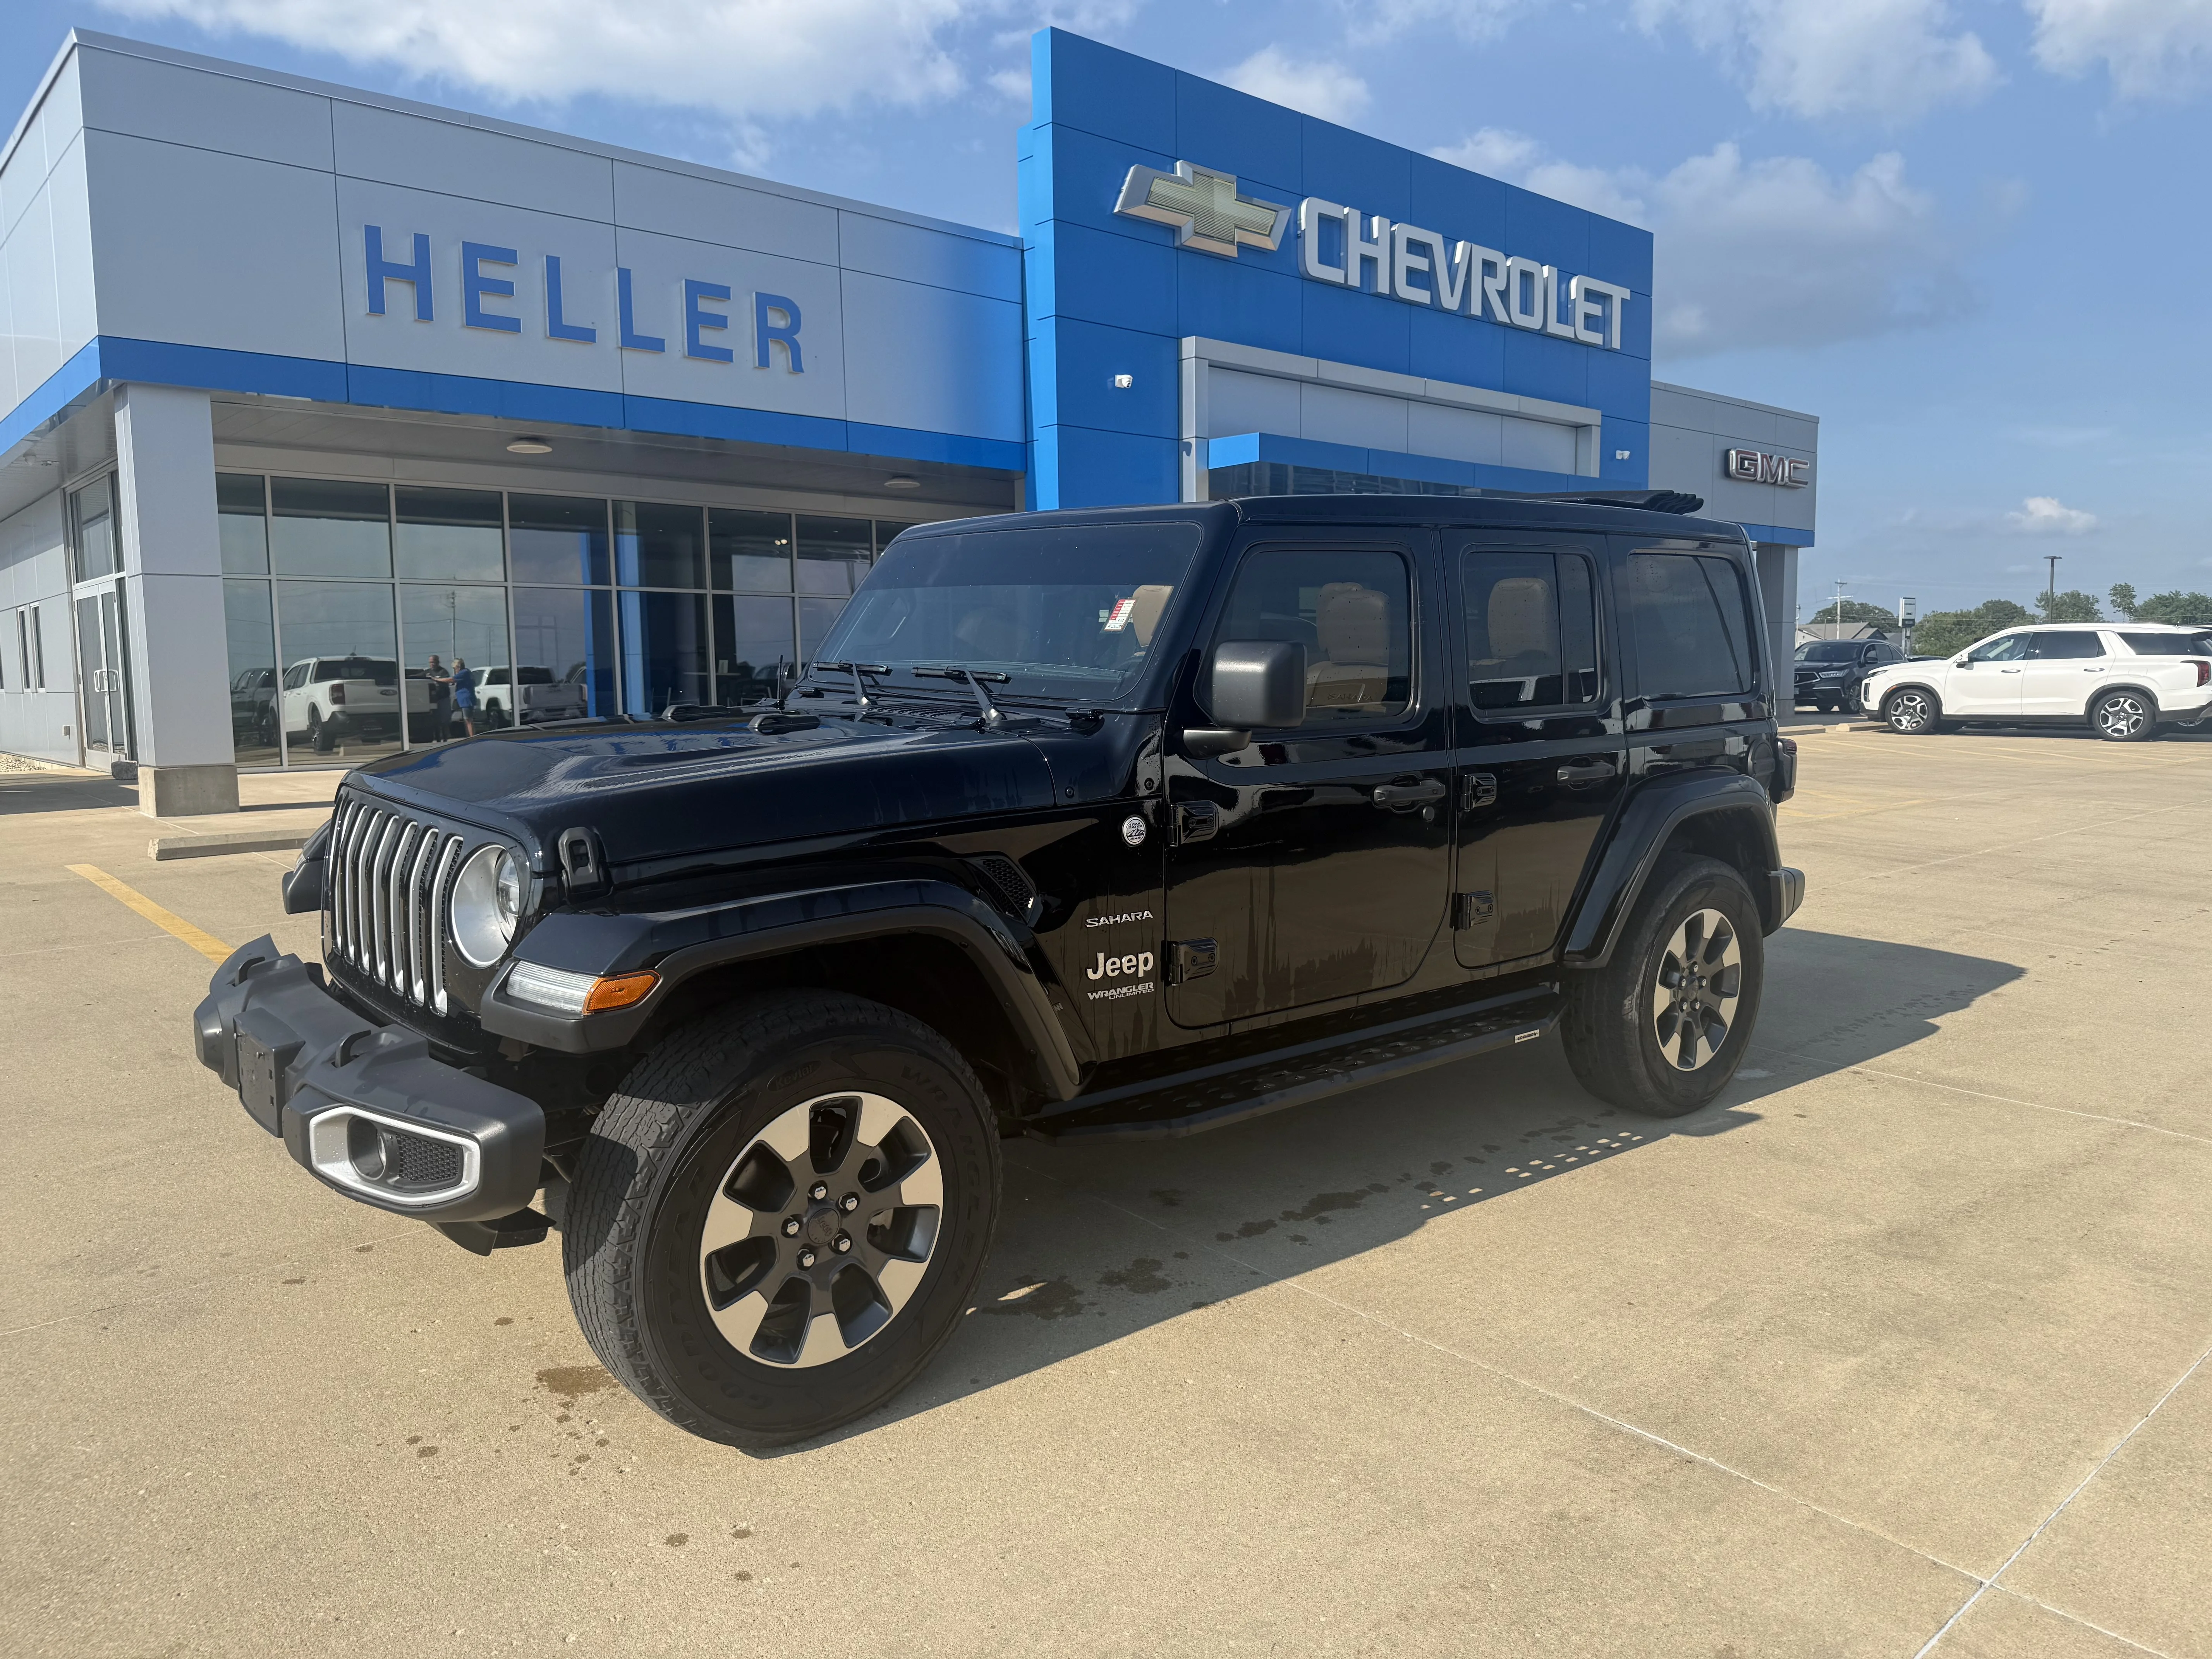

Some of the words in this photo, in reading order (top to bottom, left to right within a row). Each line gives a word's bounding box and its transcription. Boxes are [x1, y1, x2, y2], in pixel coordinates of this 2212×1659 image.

[1297, 196, 1630, 350] CHEVROLET
[364, 224, 804, 374] HELLER
[1729, 448, 1810, 488] GMC
[1085, 910, 1153, 927] SAHARA
[1087, 951, 1154, 980] Jeep
[1087, 982, 1154, 1000] WRANGLER
[1109, 988, 1154, 1000] UNLIMITED
[775, 1064, 814, 1090] Kevlar
[901, 1065, 980, 1286] WRANGLER
[667, 1166, 774, 1409] GOODYEAR
